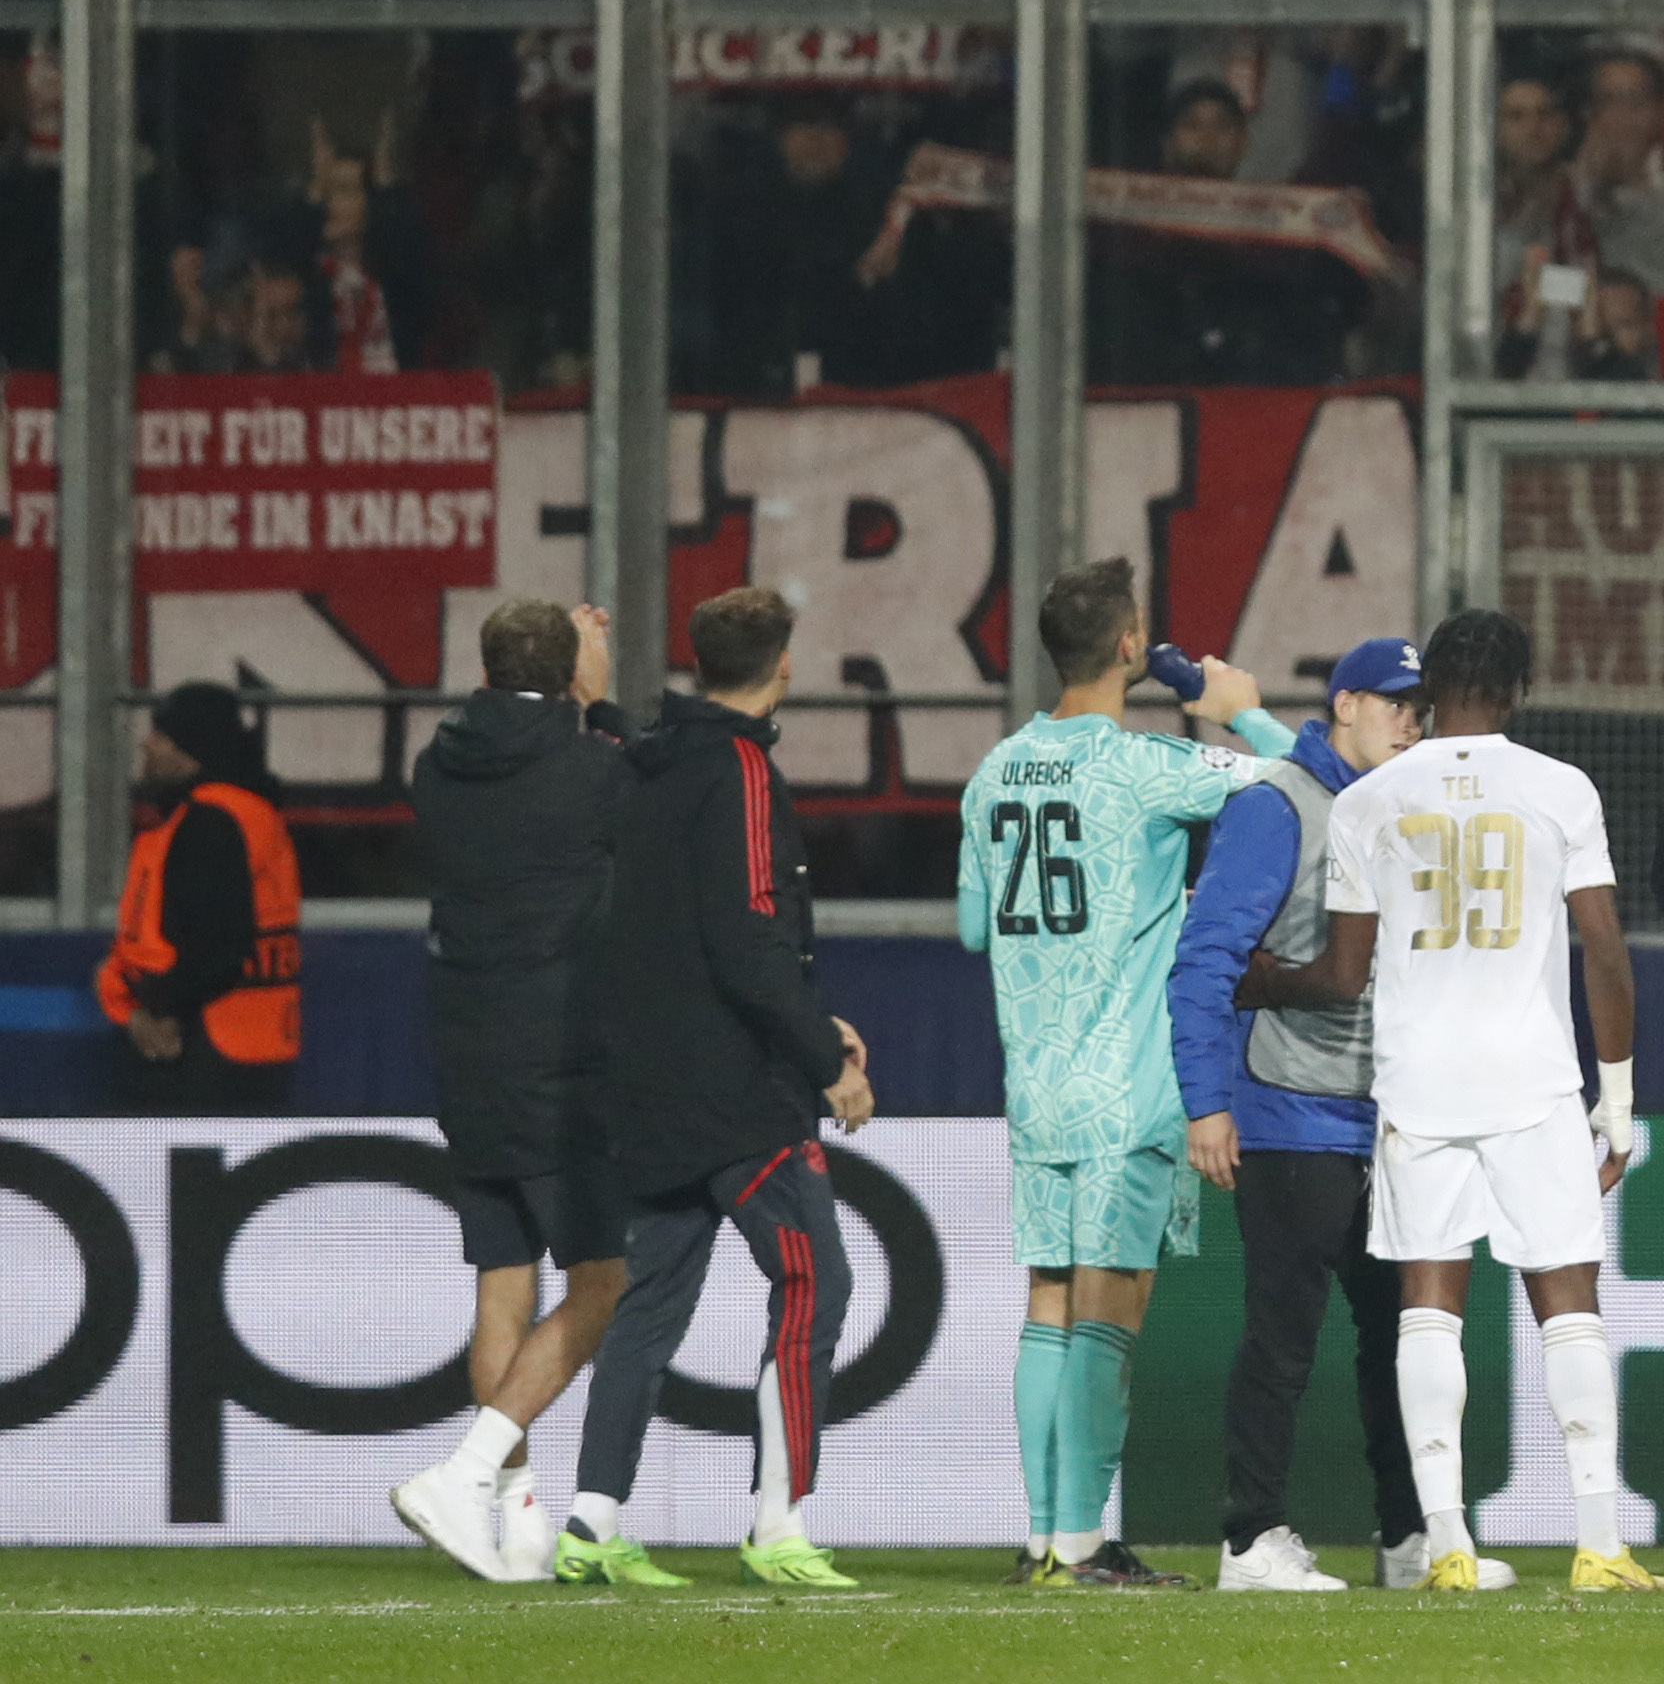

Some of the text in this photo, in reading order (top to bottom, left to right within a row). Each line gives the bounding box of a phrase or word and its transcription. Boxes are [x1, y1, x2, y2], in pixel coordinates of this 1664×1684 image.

[220, 396, 308, 467] FÜR
[318, 403, 493, 465] UNSERE
[249, 488, 312, 549] IM
[324, 487, 495, 549] KNAST
[1001, 759, 1073, 787] ULREICH
[1441, 776, 1485, 801] TEL
[991, 801, 1088, 935] 26
[1399, 812, 1525, 950] 39
